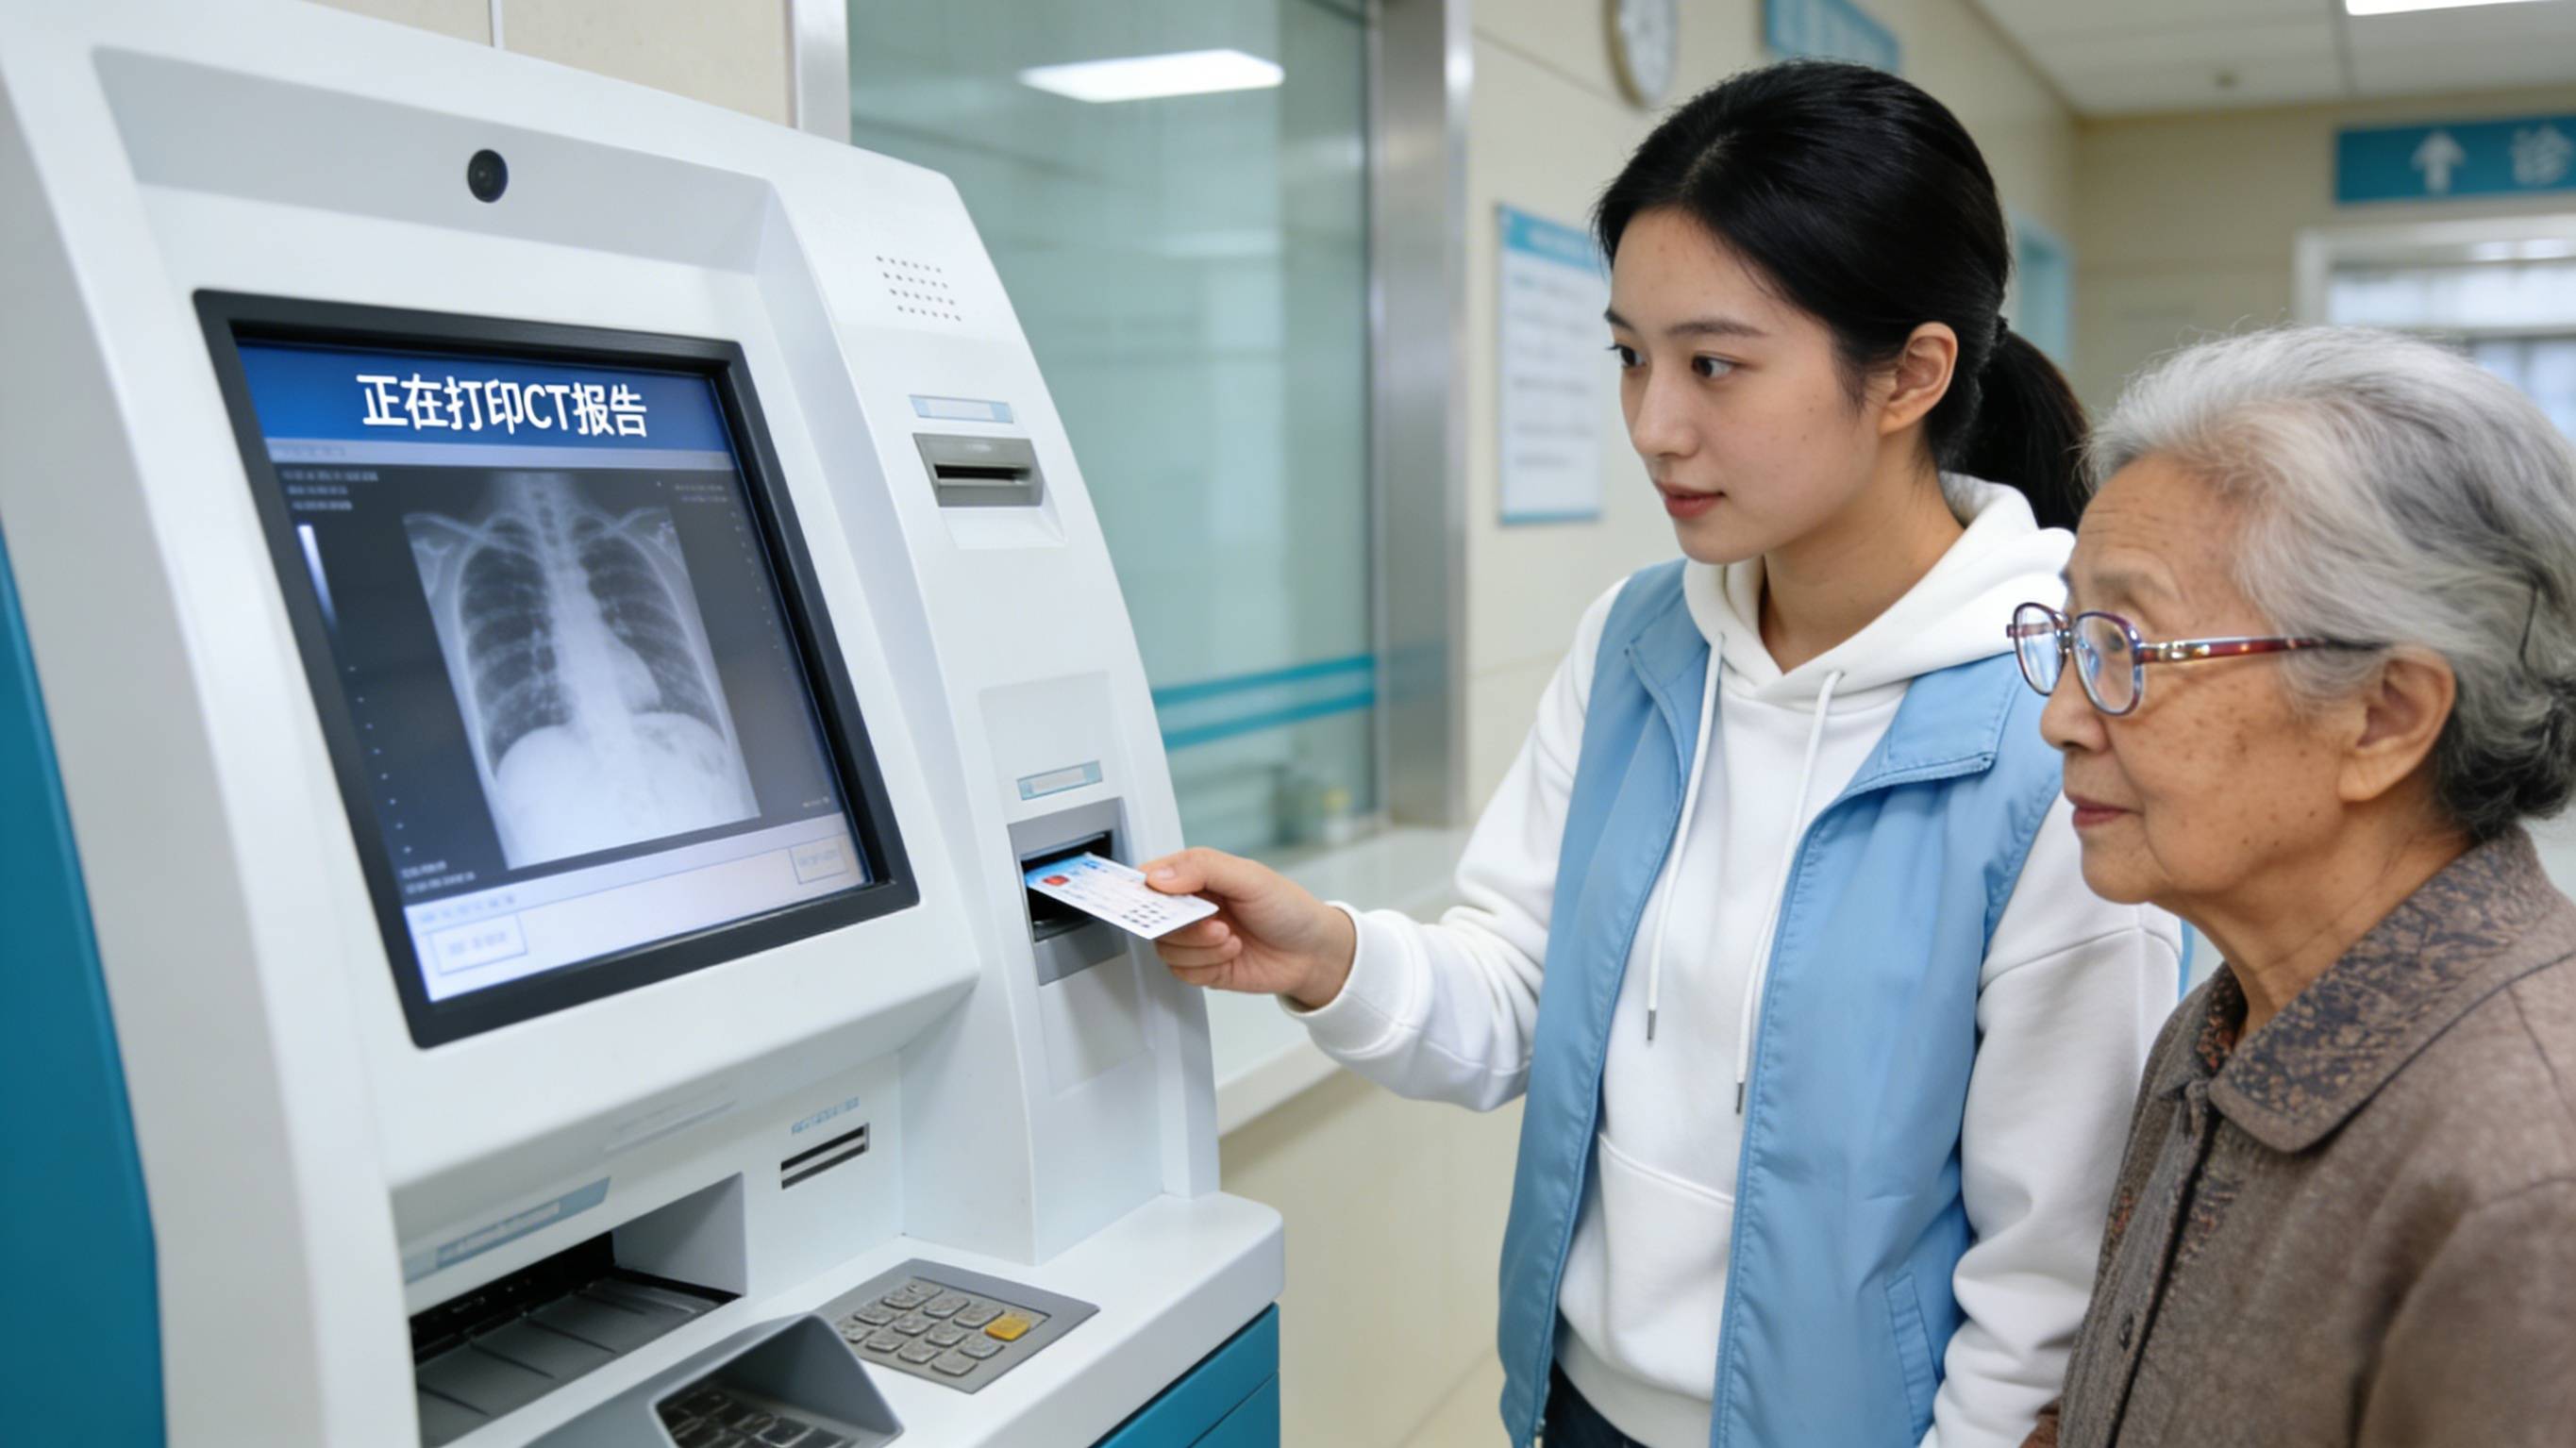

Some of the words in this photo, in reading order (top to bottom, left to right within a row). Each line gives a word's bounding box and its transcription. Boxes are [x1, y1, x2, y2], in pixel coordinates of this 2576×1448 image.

[356, 374, 647, 438] 正在打印CT报告
